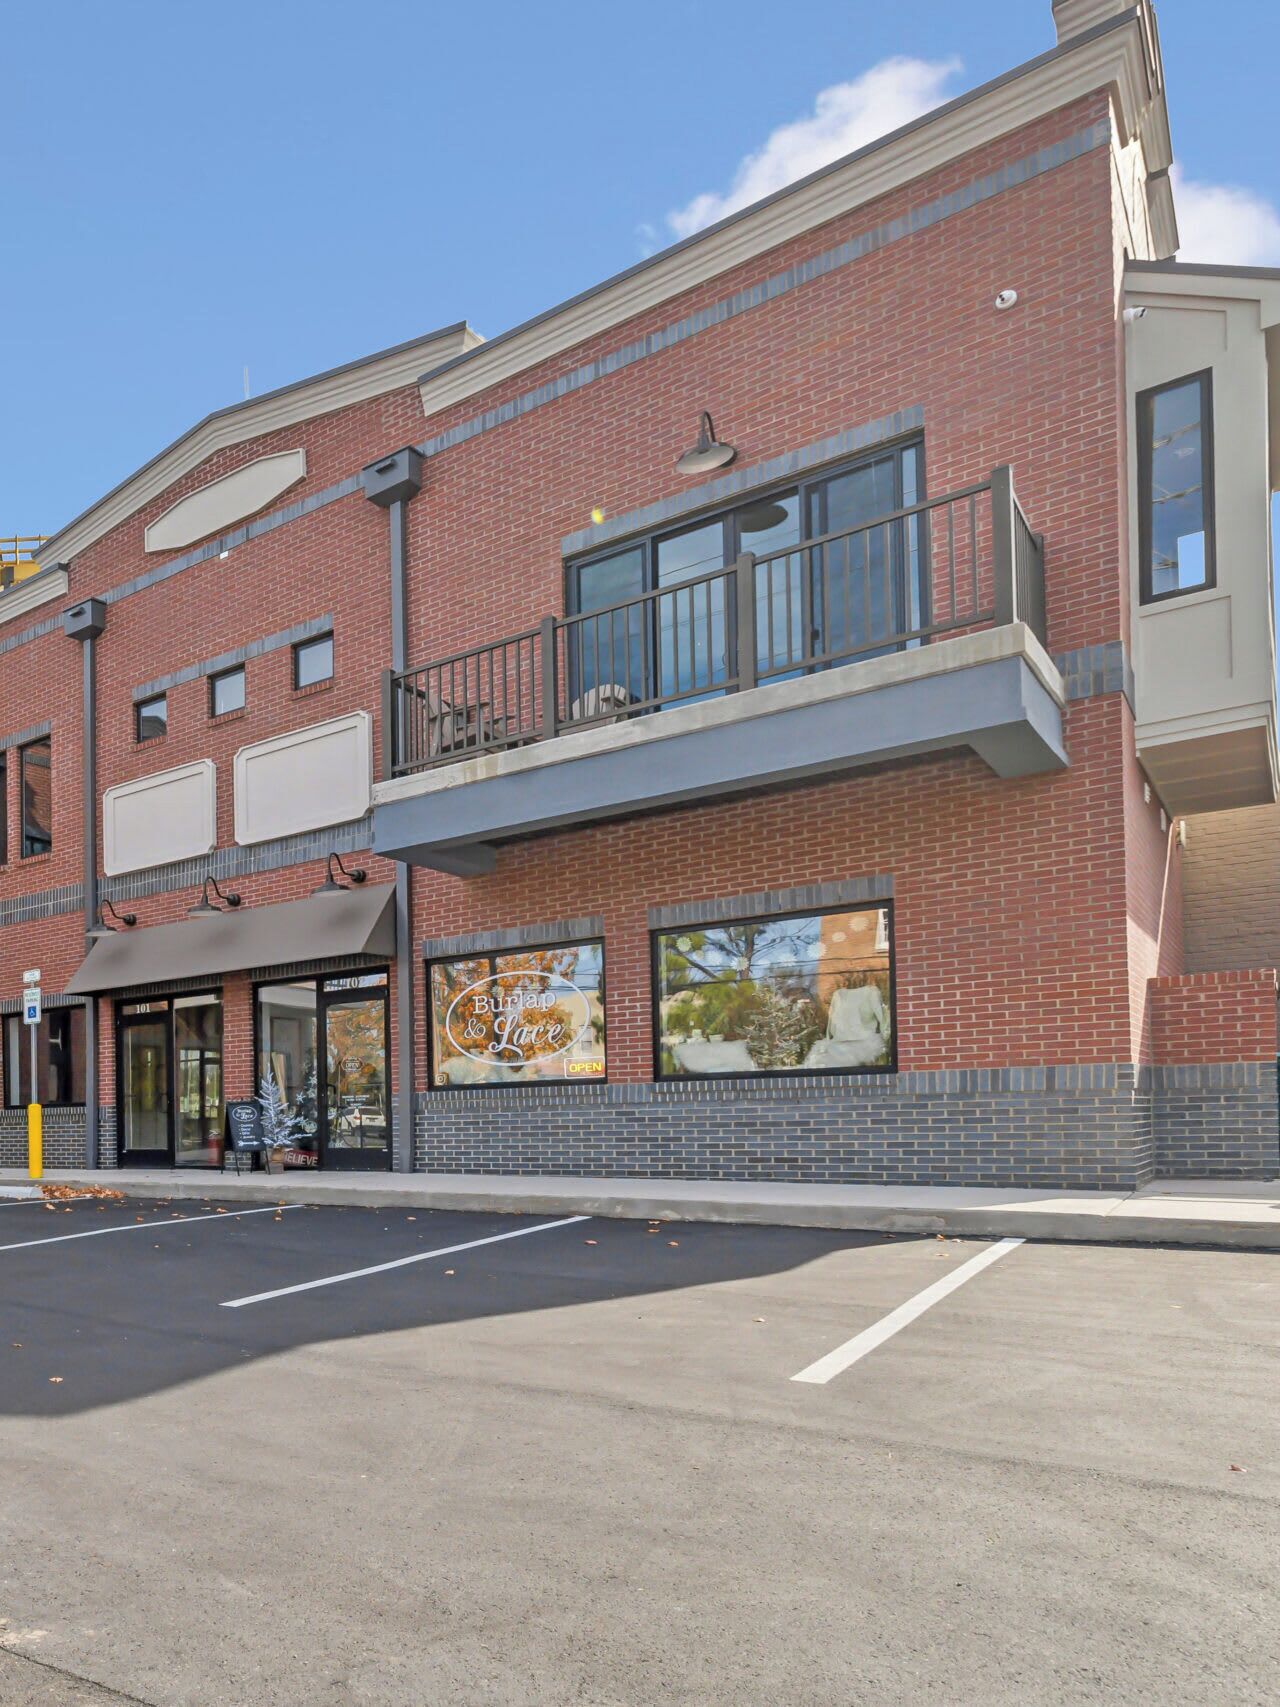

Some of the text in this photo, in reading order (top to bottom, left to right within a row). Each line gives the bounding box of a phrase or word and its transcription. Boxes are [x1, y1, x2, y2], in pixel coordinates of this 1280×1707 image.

[136, 1003, 150, 1014] 101
[472, 991, 556, 1014] Burlap
[464, 1014, 566, 1057] & Lace
[569, 1062, 602, 1073] OPEN
